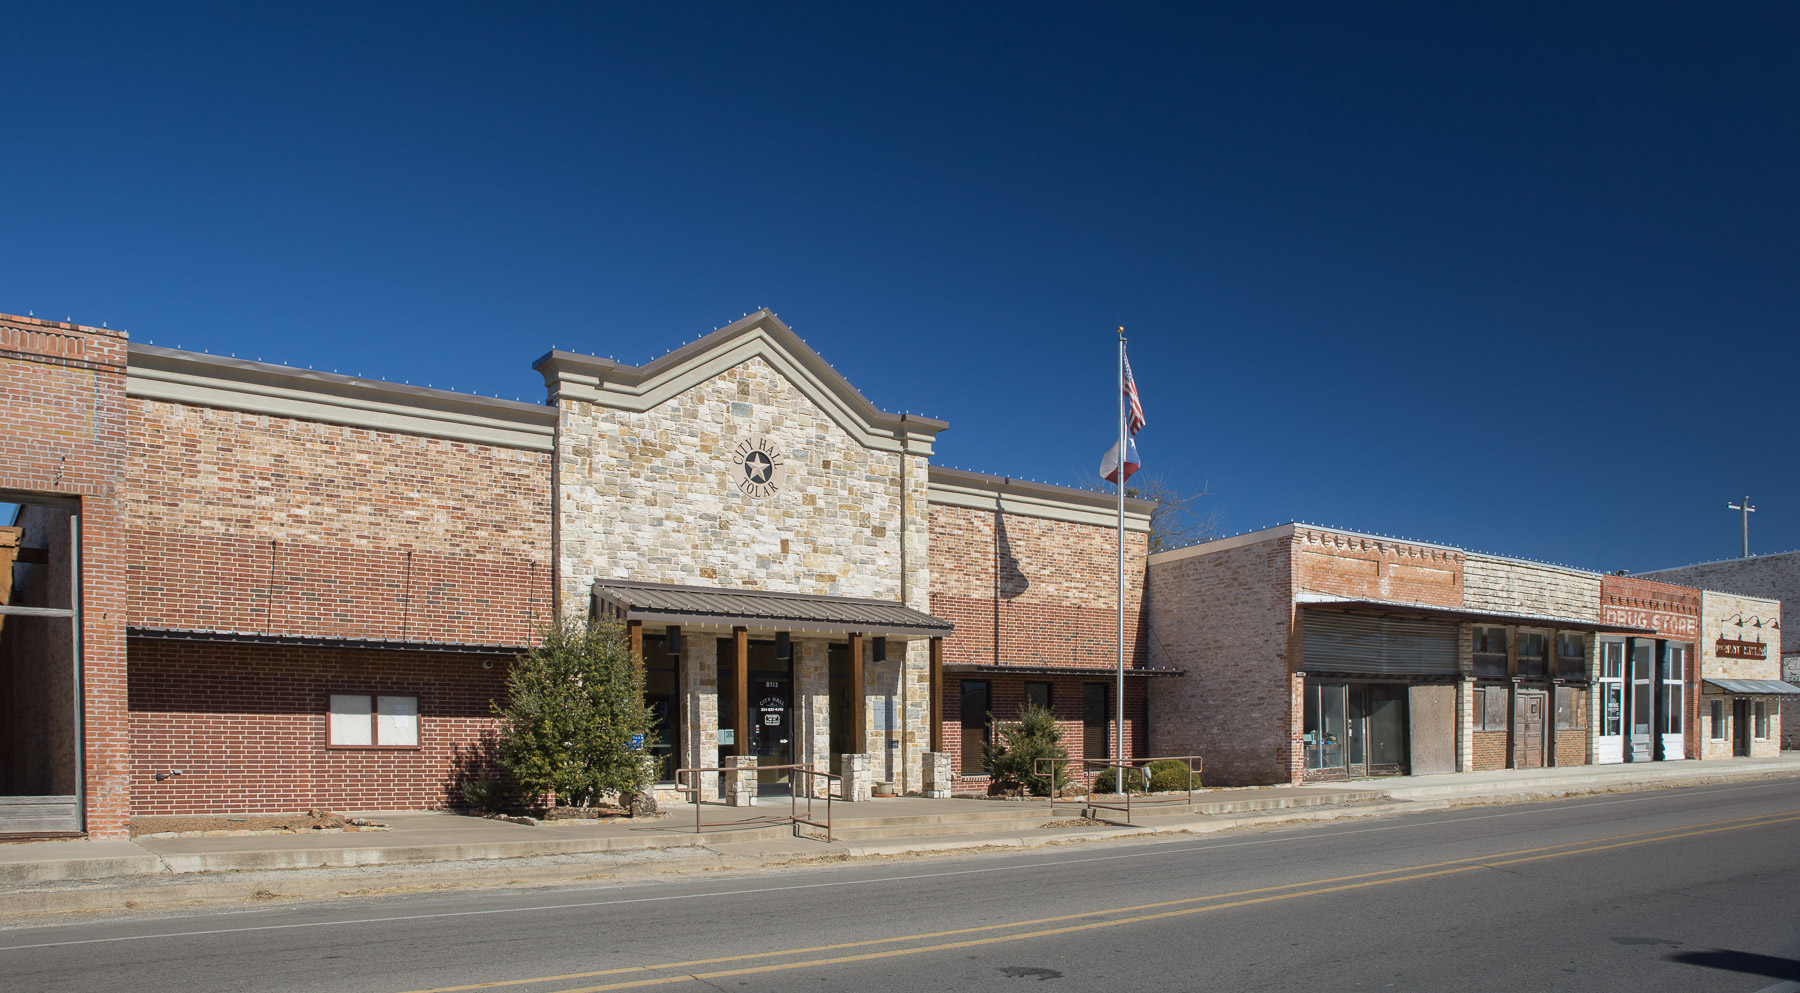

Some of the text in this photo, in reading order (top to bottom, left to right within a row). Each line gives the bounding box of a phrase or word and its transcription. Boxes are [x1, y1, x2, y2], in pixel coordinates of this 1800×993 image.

[733, 438, 783, 469] CITY HALL
[740, 477, 778, 498] TOLAR
[1606, 609, 1696, 635] DRUG STORE
[760, 697, 771, 706] CITY
